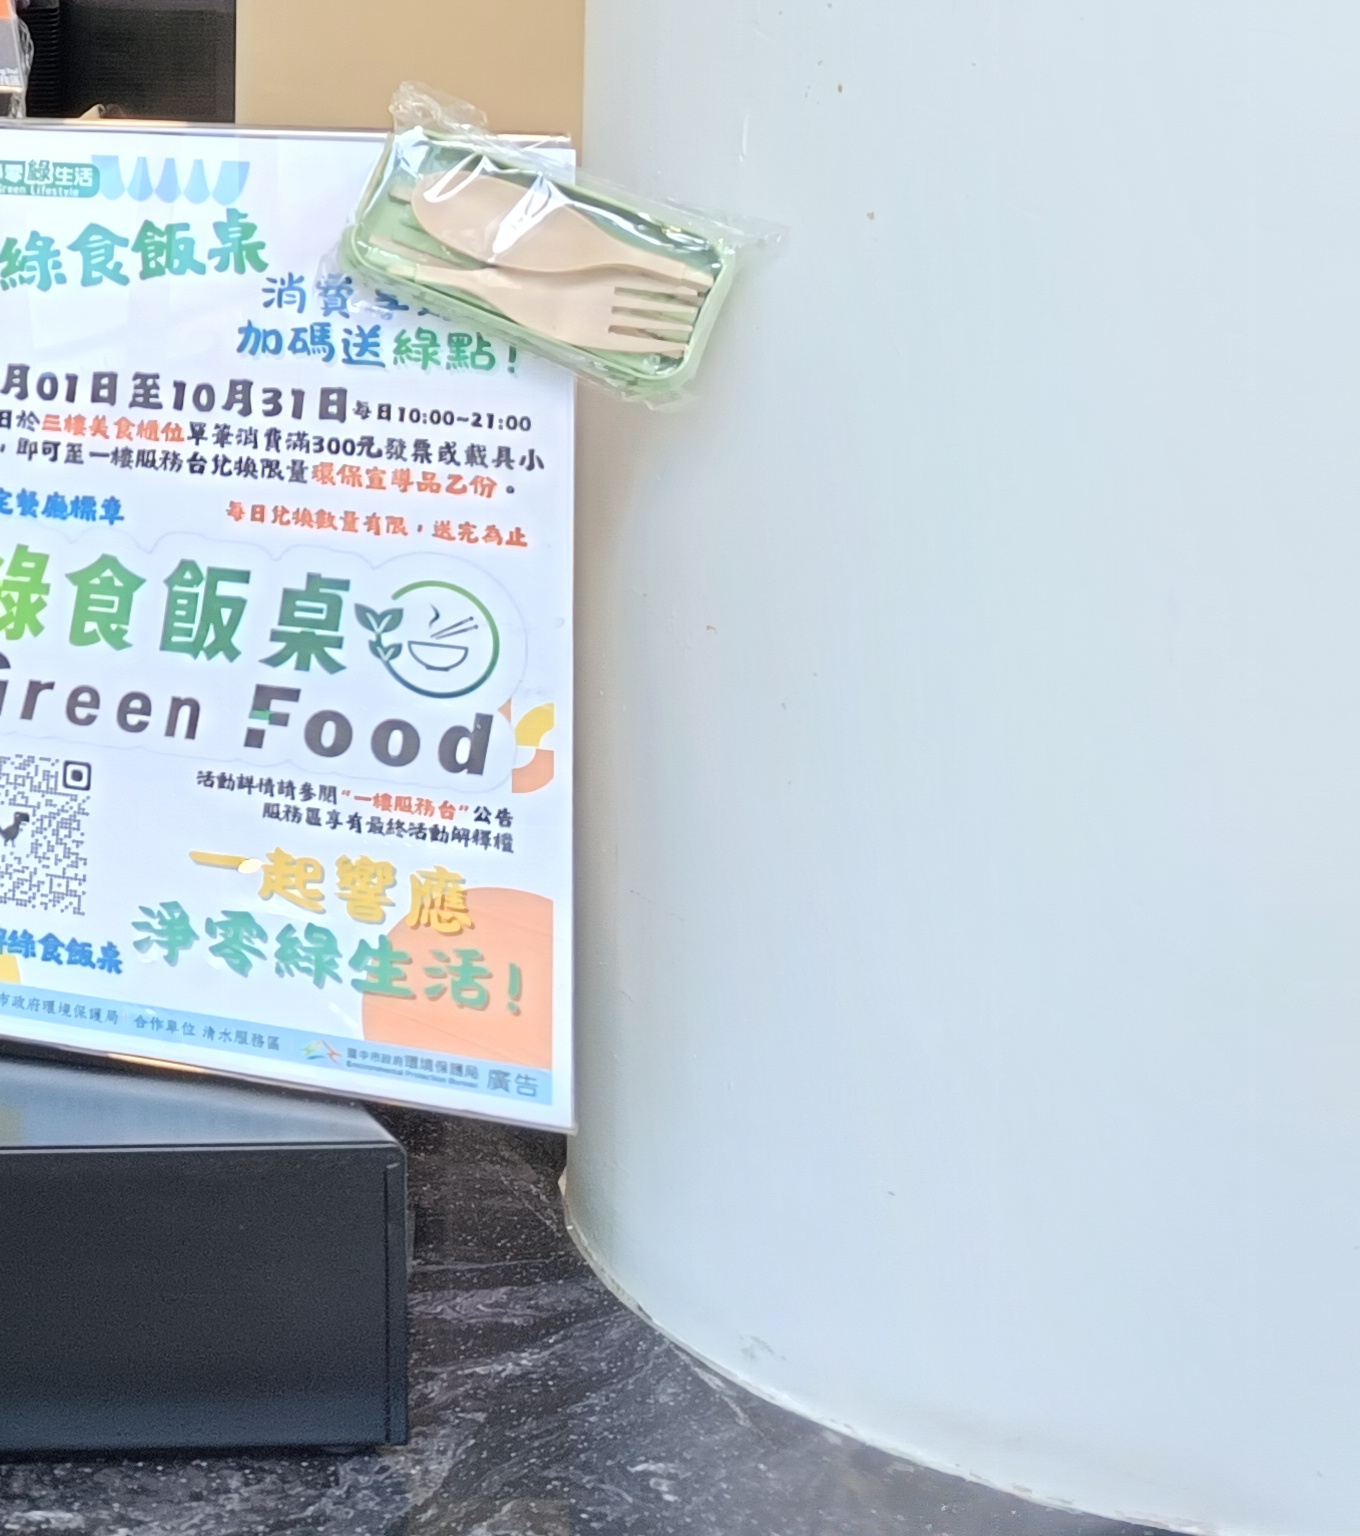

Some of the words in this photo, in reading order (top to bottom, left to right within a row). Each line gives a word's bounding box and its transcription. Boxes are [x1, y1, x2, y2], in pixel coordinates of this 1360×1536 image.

[236, 319, 519, 375] 加碼送綠點!
[242, 682, 496, 776] Food
[188, 847, 475, 934] 一起響應
[131, 900, 523, 1015] 淨零綠生活!
[133, 1014, 197, 1038] 合作單位
[202, 1025, 281, 1052] 清水服務區
[486, 1068, 539, 1098] 廣告
